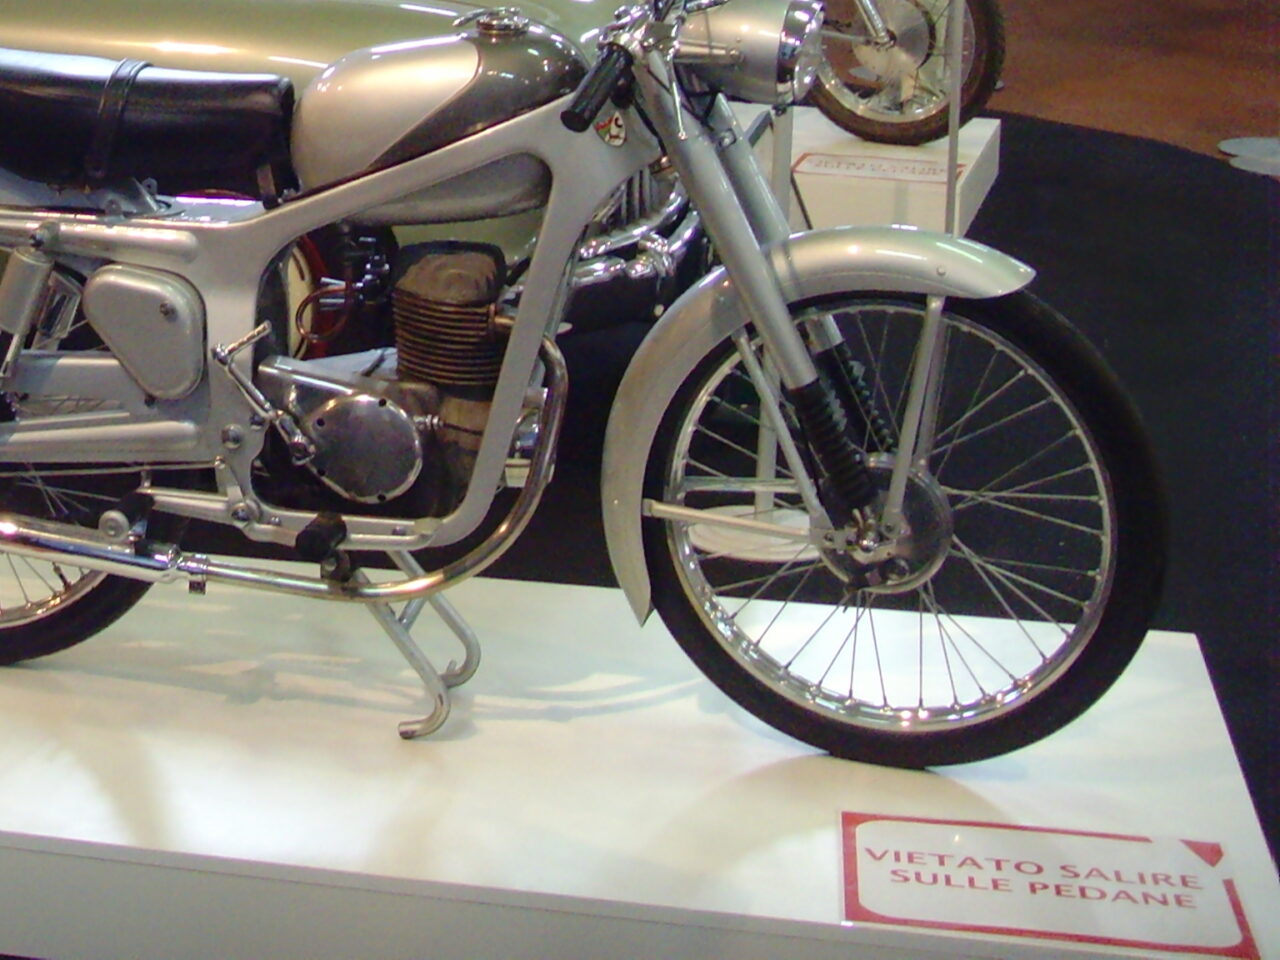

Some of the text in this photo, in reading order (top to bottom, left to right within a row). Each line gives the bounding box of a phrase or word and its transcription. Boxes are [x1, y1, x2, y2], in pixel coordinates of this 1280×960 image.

[864, 846, 1204, 890] VIETATO SALIRE
[890, 868, 1198, 909] SULLE PEDANE
